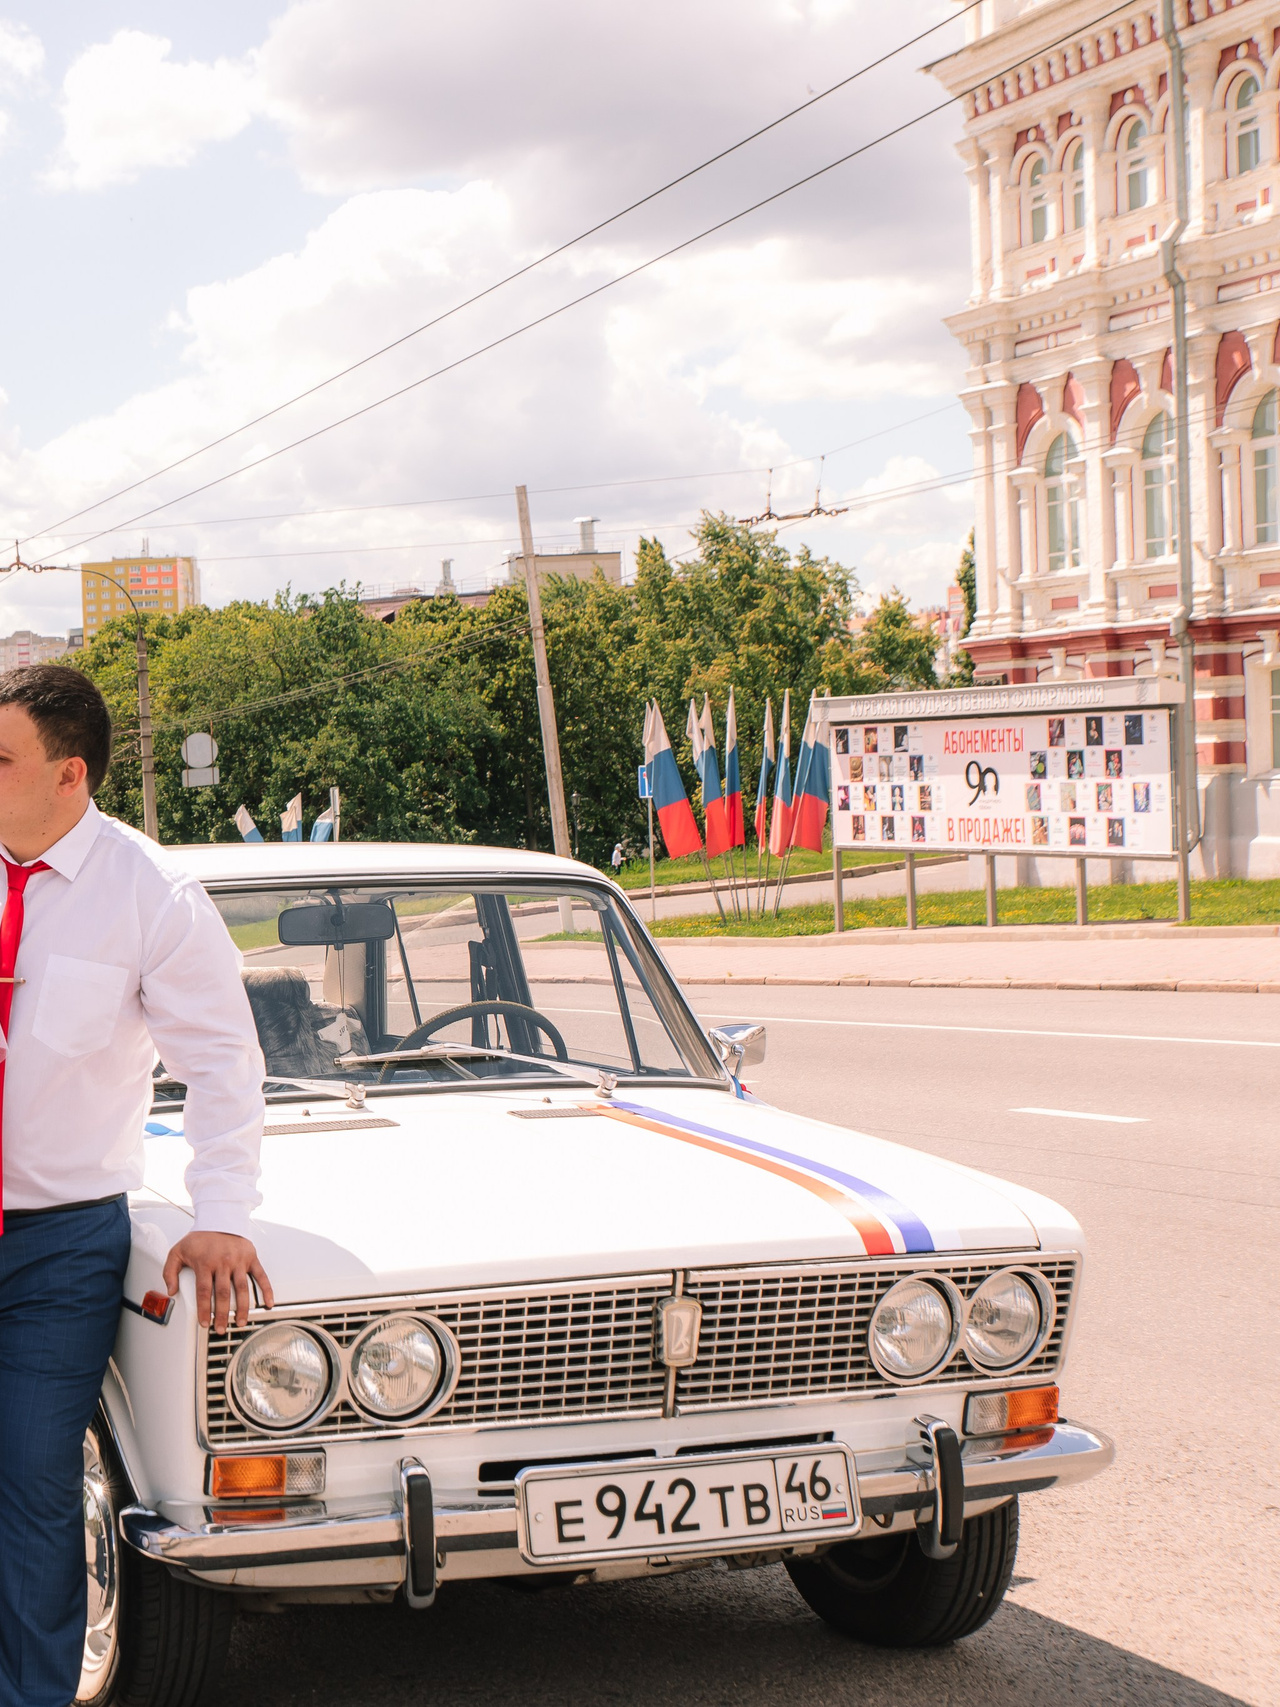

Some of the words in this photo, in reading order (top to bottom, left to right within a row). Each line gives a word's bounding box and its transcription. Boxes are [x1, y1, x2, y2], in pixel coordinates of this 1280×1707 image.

[850, 698, 898, 717] КУРСКАЯ
[900, 689, 1009, 715] ГОСУДАРСТВЕННАЯ
[1011, 683, 1105, 709] ФИЛАРМОНИЯ
[944, 728, 1025, 754] АБОНЕМЕНТЫ
[947, 817, 955, 842] В
[958, 817, 1026, 845] ПРОДАЖЕ!
[784, 1460, 832, 1504] 46
[784, 1505, 820, 1524] RUS
